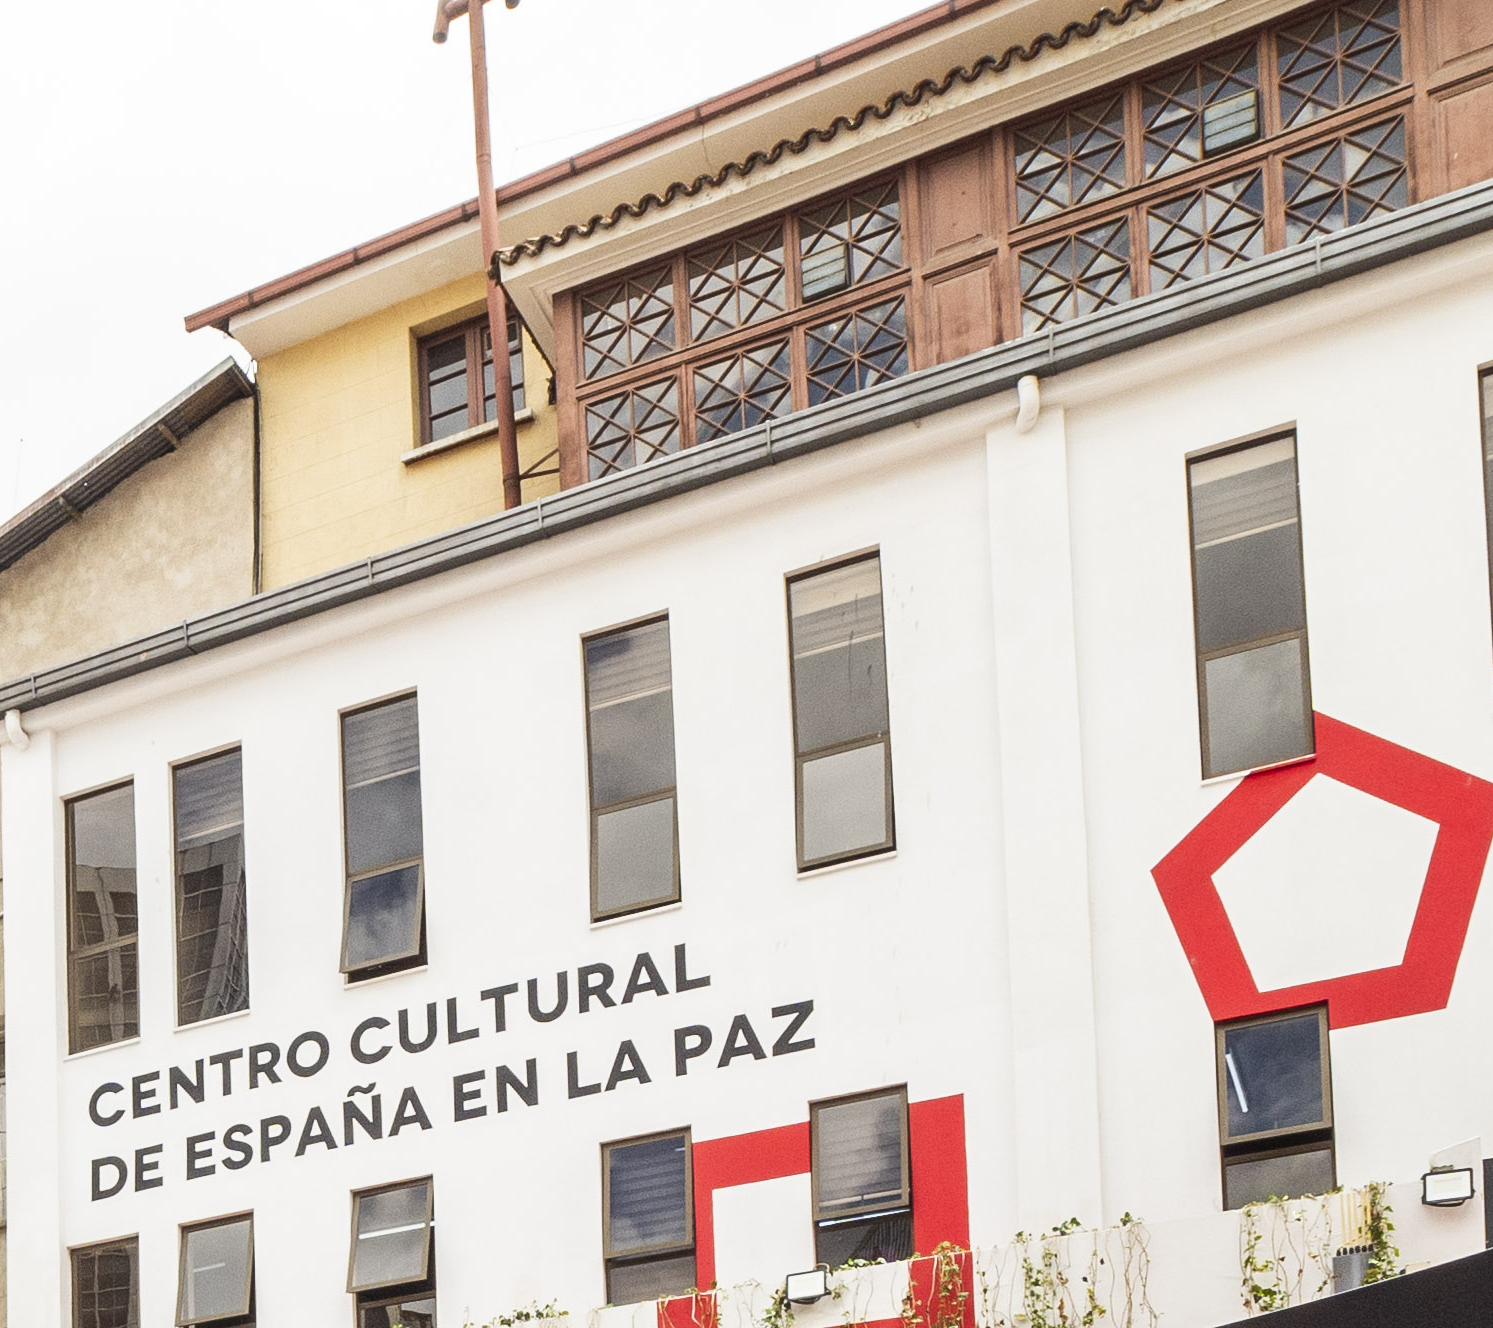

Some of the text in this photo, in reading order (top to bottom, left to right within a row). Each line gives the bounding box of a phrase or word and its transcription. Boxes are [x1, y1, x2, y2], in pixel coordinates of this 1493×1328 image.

[87, 942, 712, 1128] CENTRO CULTURAL
[90, 998, 817, 1203] DE ESPAÑA EN LA PAZ
